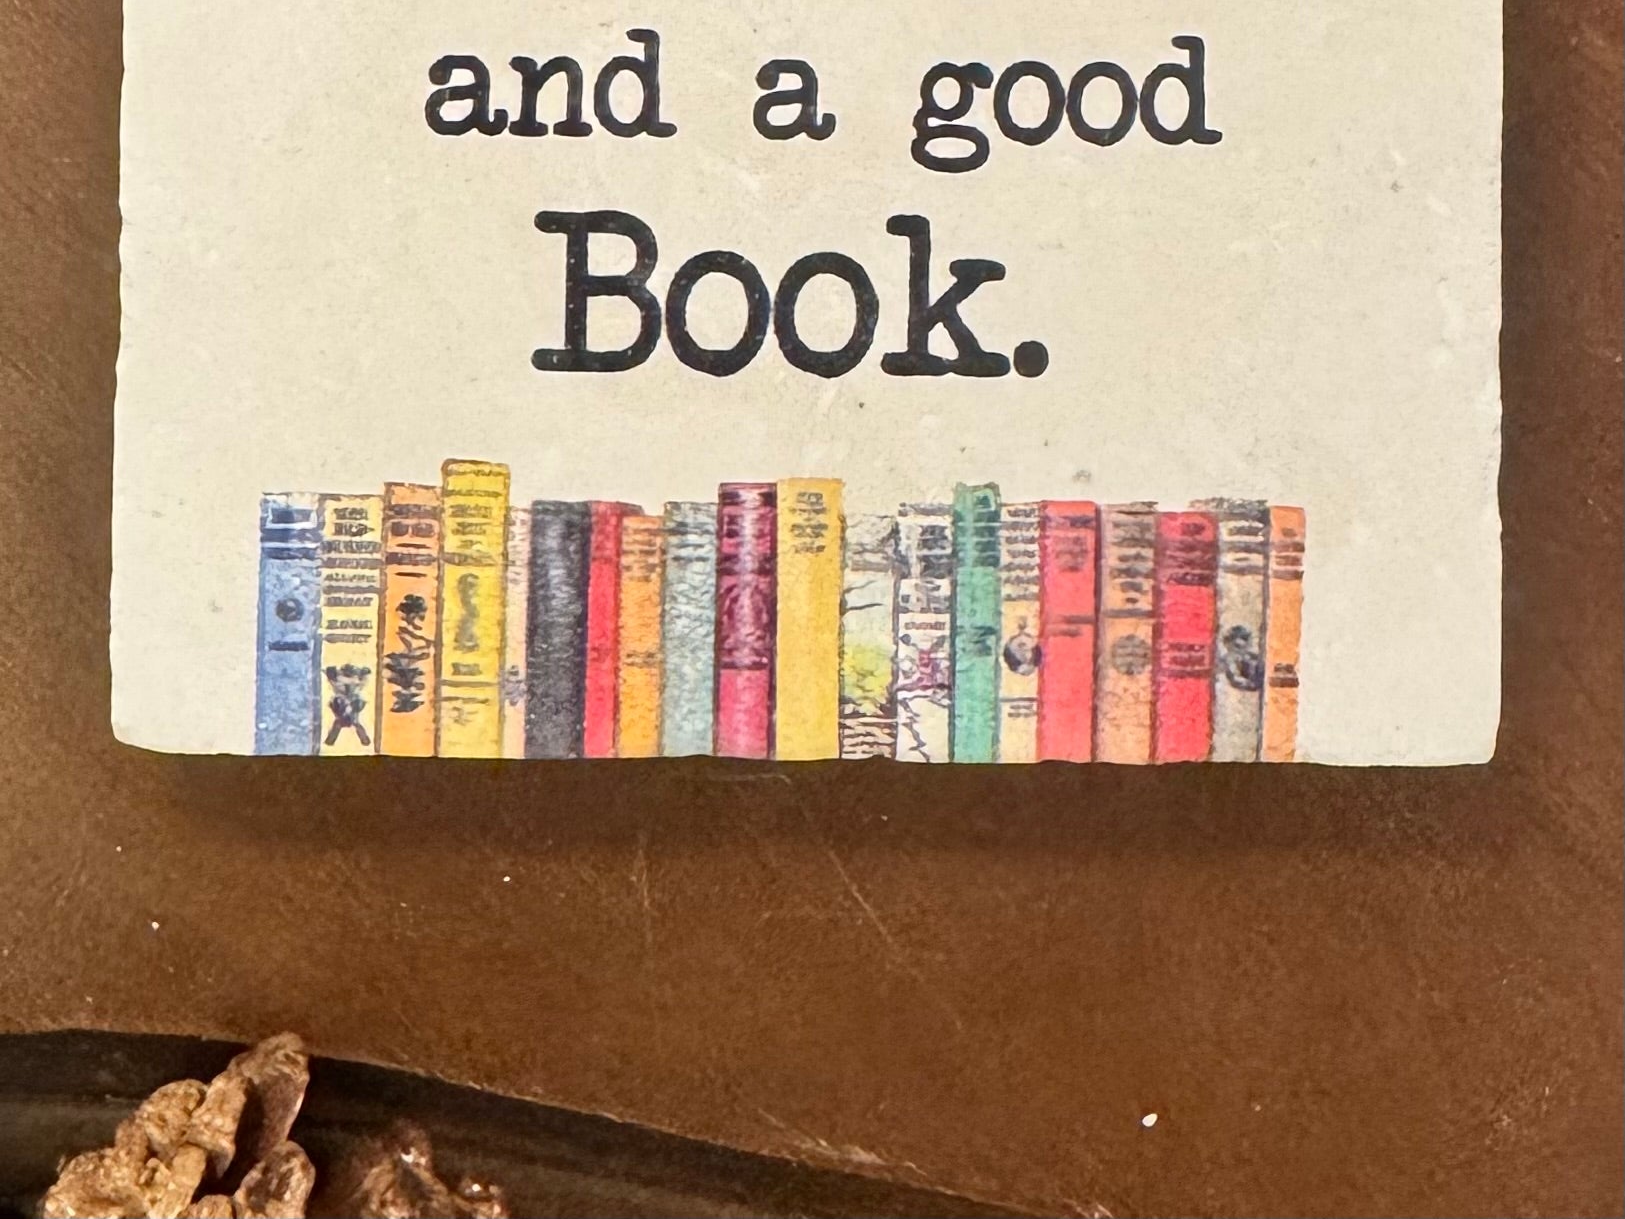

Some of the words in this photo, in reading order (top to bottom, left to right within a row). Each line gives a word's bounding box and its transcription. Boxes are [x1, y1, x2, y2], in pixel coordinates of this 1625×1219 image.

[424, 28, 678, 138] and
[752, 59, 836, 141] a
[910, 35, 1223, 174] good
[531, 209, 1049, 379] Book.
